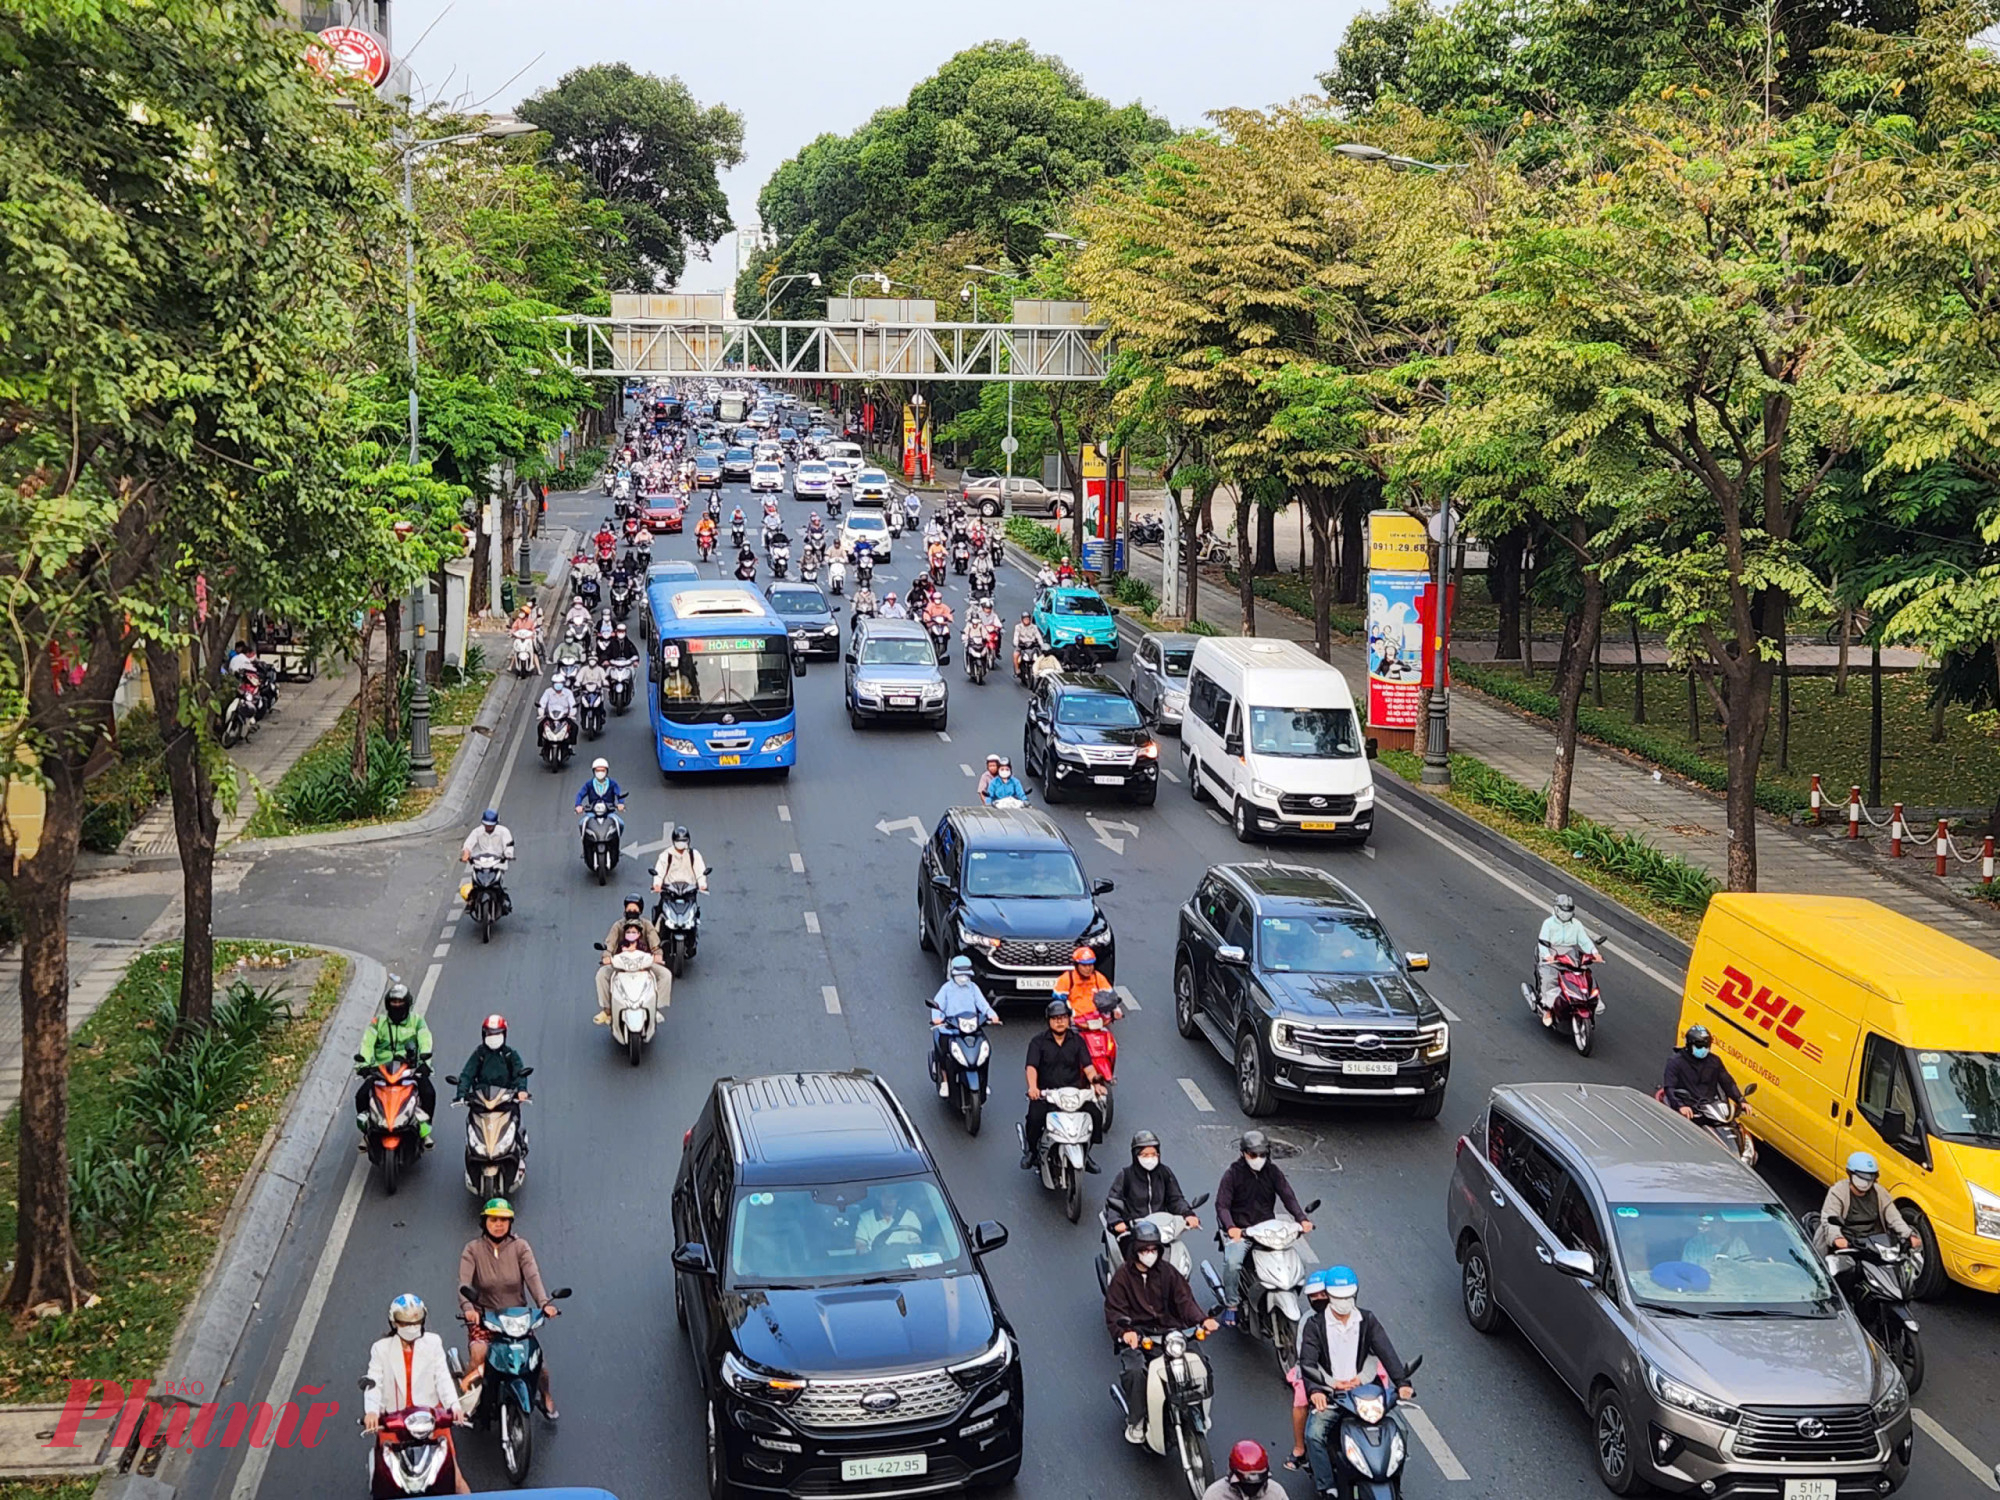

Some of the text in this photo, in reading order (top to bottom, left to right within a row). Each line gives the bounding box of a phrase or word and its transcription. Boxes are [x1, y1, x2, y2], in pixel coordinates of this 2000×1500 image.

[665, 647, 678, 656] 04
[1716, 964, 1806, 1050] DHL
[1727, 1045, 1748, 1065] SIMPLY
[849, 1460, 919, 1476] 51L-427.95
[1800, 1482, 1822, 1493] 51H
